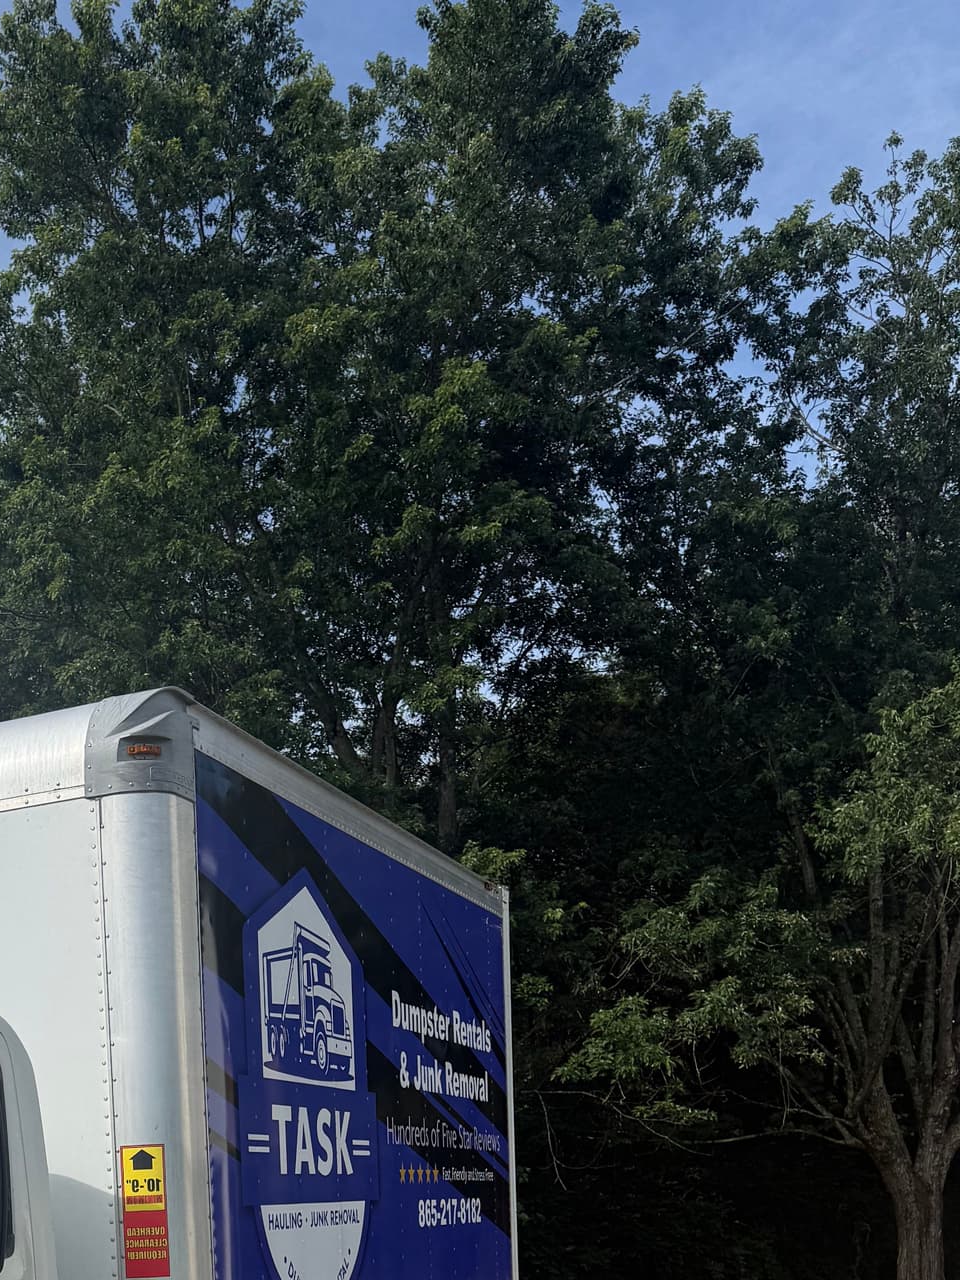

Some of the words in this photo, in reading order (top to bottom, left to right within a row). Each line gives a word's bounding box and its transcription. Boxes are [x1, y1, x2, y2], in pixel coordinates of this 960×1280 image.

[391, 990, 450, 1044] Dumpster
[453, 1010, 491, 1052] Rentals
[399, 1051, 410, 1089] &
[414, 1055, 443, 1094] Junk
[445, 1061, 489, 1102] Removal
[271, 1104, 354, 1176] TASK
[386, 1116, 429, 1147] Hundreds
[431, 1120, 440, 1148] of
[442, 1122, 457, 1149] Five
[459, 1125, 473, 1150] Star
[473, 1126, 501, 1152] Reviews
[268, 1212, 302, 1230] HAULING
[310, 1210, 328, 1227] JUNK
[330, 1208, 360, 1225] REMOVAL
[418, 1197, 482, 1227] 865-217-8182
